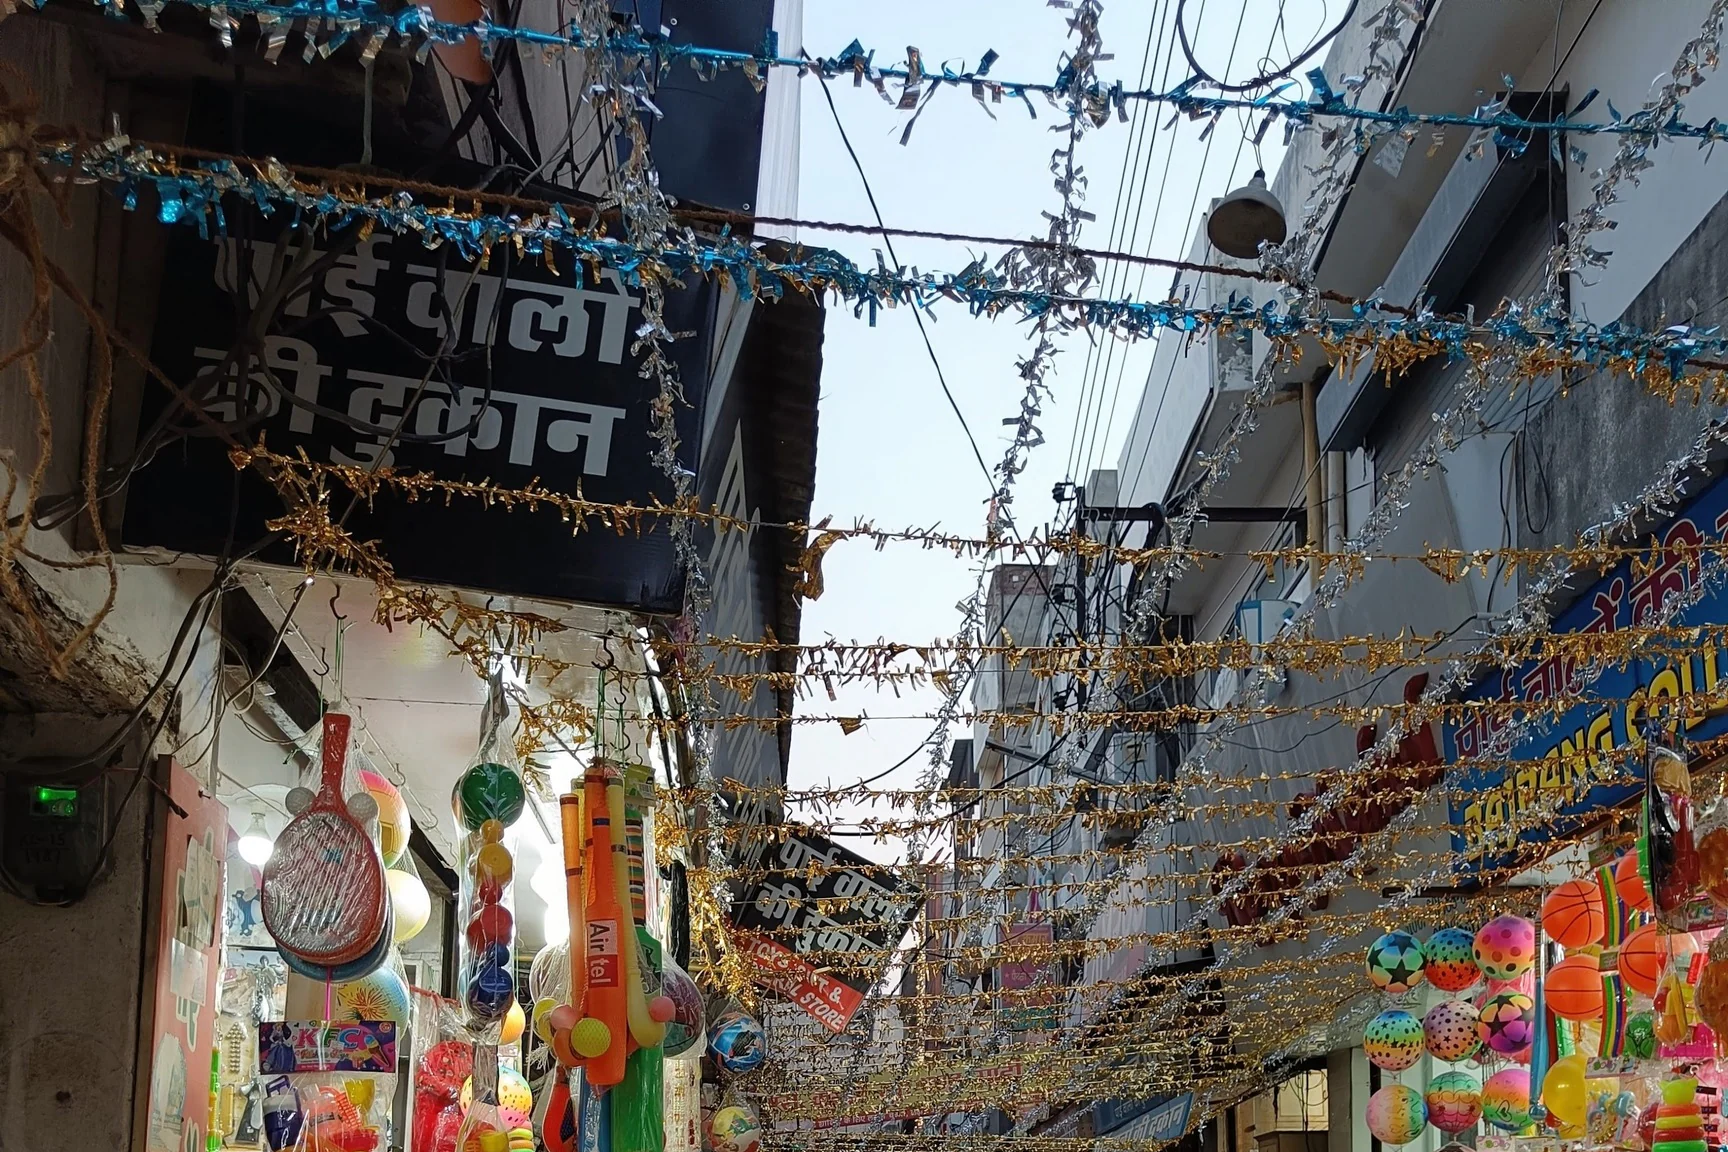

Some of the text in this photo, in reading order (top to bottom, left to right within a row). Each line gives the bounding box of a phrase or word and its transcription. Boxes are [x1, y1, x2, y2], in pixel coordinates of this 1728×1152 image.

[329, 370, 626, 477] दुकान
[1629, 518, 1705, 630] की
[755, 882, 802, 929] की
[801, 992, 846, 1031] STORE
[295, 1028, 361, 1049] KFC
